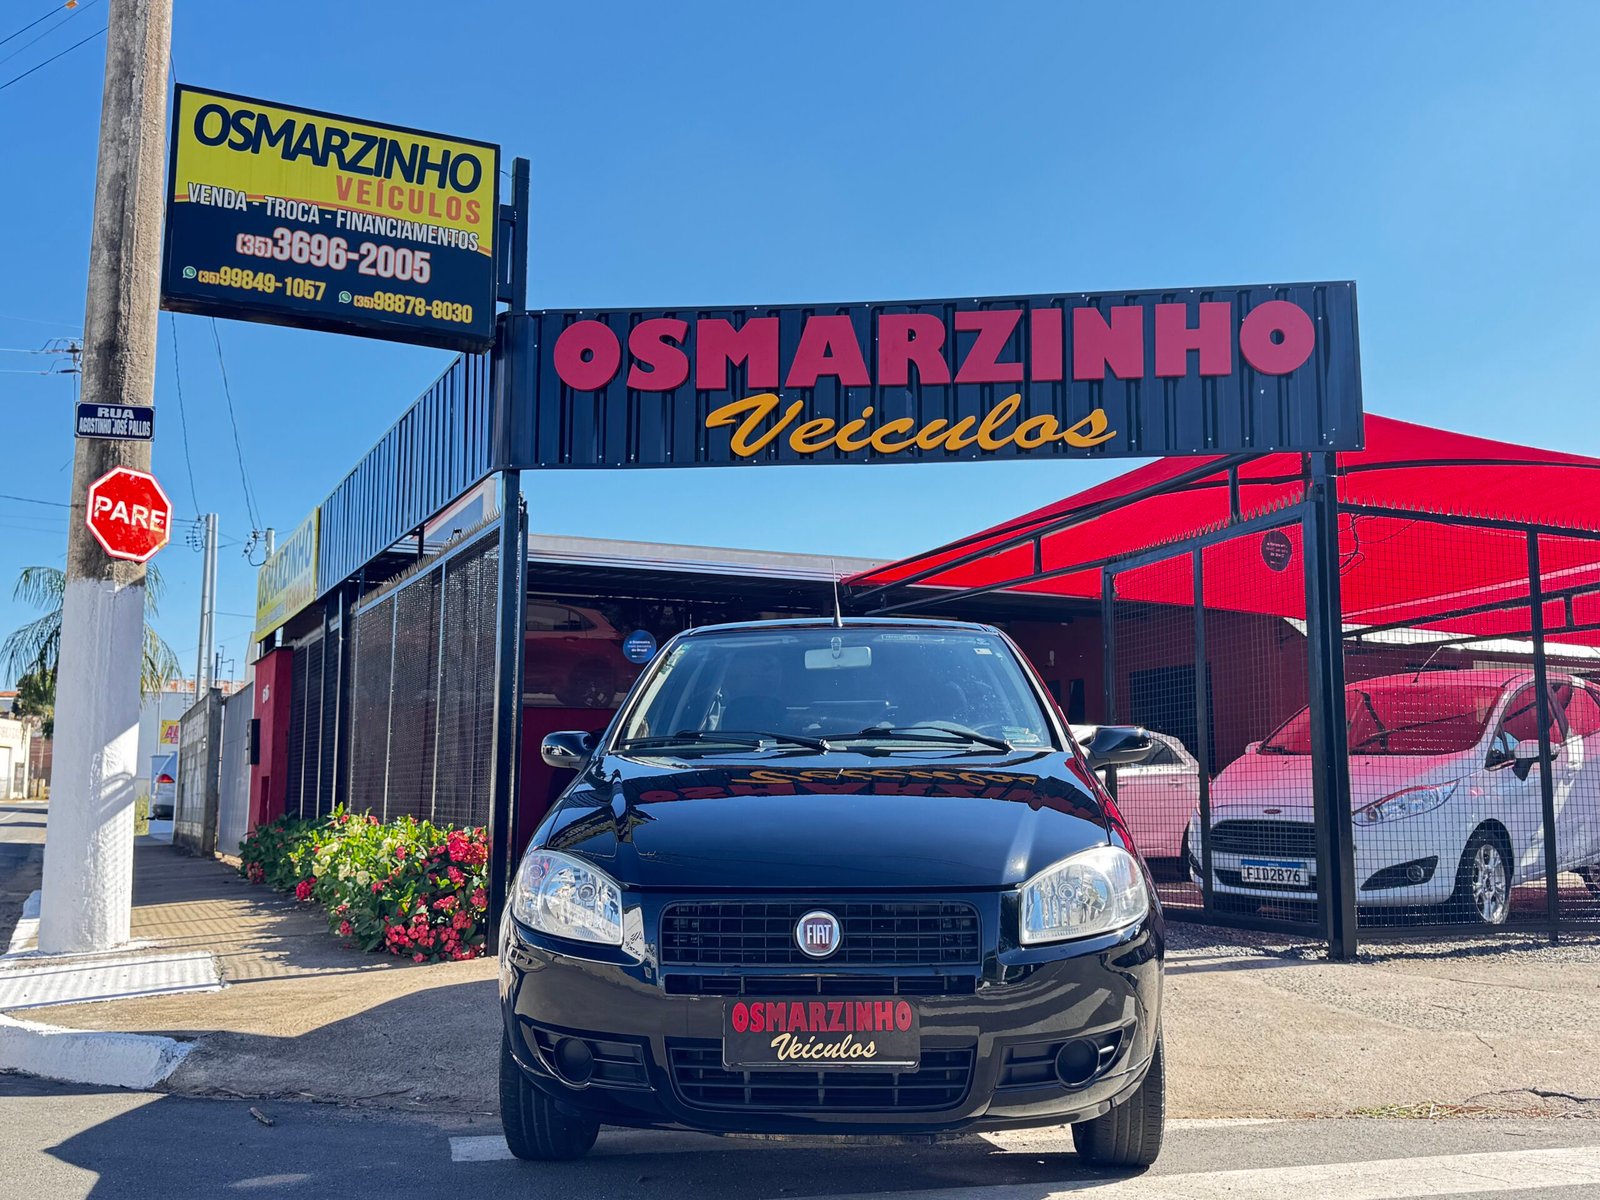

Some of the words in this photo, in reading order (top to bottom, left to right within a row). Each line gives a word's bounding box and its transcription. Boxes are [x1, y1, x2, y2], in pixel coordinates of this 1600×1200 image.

[193, 103, 482, 194] OSMARZINHO
[187, 181, 248, 212] VENDA
[264, 195, 320, 225] TROCA
[336, 208, 480, 252] FINANCIAMENTOS
[335, 174, 481, 225] VEÍCULOS
[235, 226, 431, 284] (35)3696-2005
[553, 300, 1316, 392] OSMARZINHO
[78, 417, 112, 434] AGOSTINHO
[112, 417, 128, 435] JOSÉ
[128, 420, 151, 437] PALLOS
[97, 407, 134, 419] RUA
[93, 495, 166, 534] PARE
[1246, 867, 1301, 882] FID2B76
[806, 924, 832, 945] FIAT
[731, 1000, 913, 1033] OSMARZINHO
